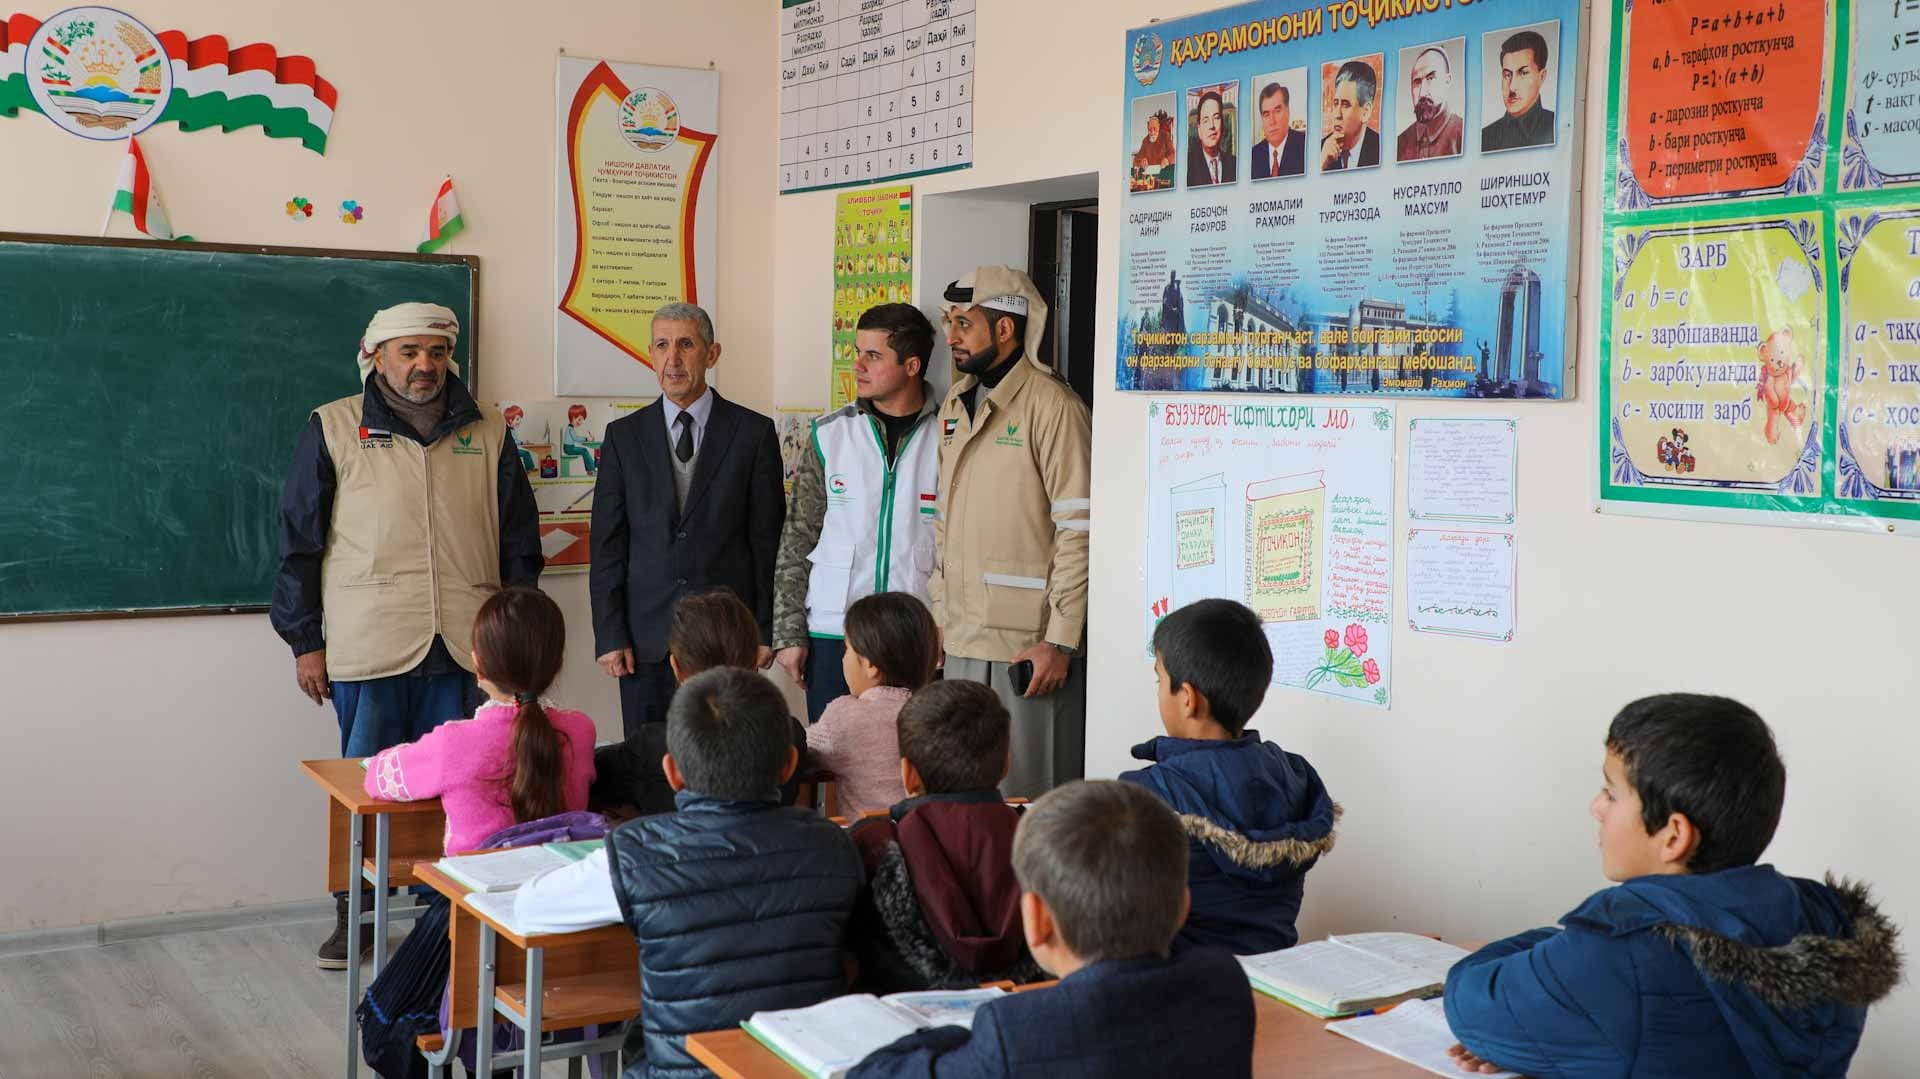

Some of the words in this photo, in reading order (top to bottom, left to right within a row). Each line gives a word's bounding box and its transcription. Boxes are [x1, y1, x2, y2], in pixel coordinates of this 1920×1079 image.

[1170, 7, 1323, 67] ҚАҲРАМОНОНИ
[937, 61, 941, 73] 3
[961, 55, 966, 67] 8
[912, 96, 917, 107] 5
[911, 127, 916, 138] 9
[957, 144, 962, 156] 2
[1665, 132, 1690, 152] бари
[1665, 159, 1723, 179] периметри
[1393, 181, 1462, 200] НУСРАТУЛЛО
[1480, 172, 1551, 191] ШИРИНШОҲ
[1334, 191, 1366, 206] МИРЗО
[1481, 191, 1546, 209] ШОҲТЕМУР
[1130, 211, 1172, 224] САДРИДДИН
[1320, 207, 1381, 224] ТУРСУНЗОДА
[1404, 201, 1449, 216] МАХСУМ
[1255, 214, 1295, 228] РАҲМОН
[1680, 244, 1727, 270] ЗАРБ
[1320, 331, 1349, 344] вале
[1415, 328, 1463, 343] асосии
[1651, 323, 1758, 348] зарбшаванда
[1126, 356, 1137, 368] он
[1140, 353, 1200, 370] фарзандони
[1299, 357, 1312, 369] ва
[1403, 352, 1477, 372] мебошанд.
[1650, 360, 1756, 388] зарбкунанда
[1649, 402, 1704, 420] ҳосили
[1714, 398, 1751, 424] зарб
